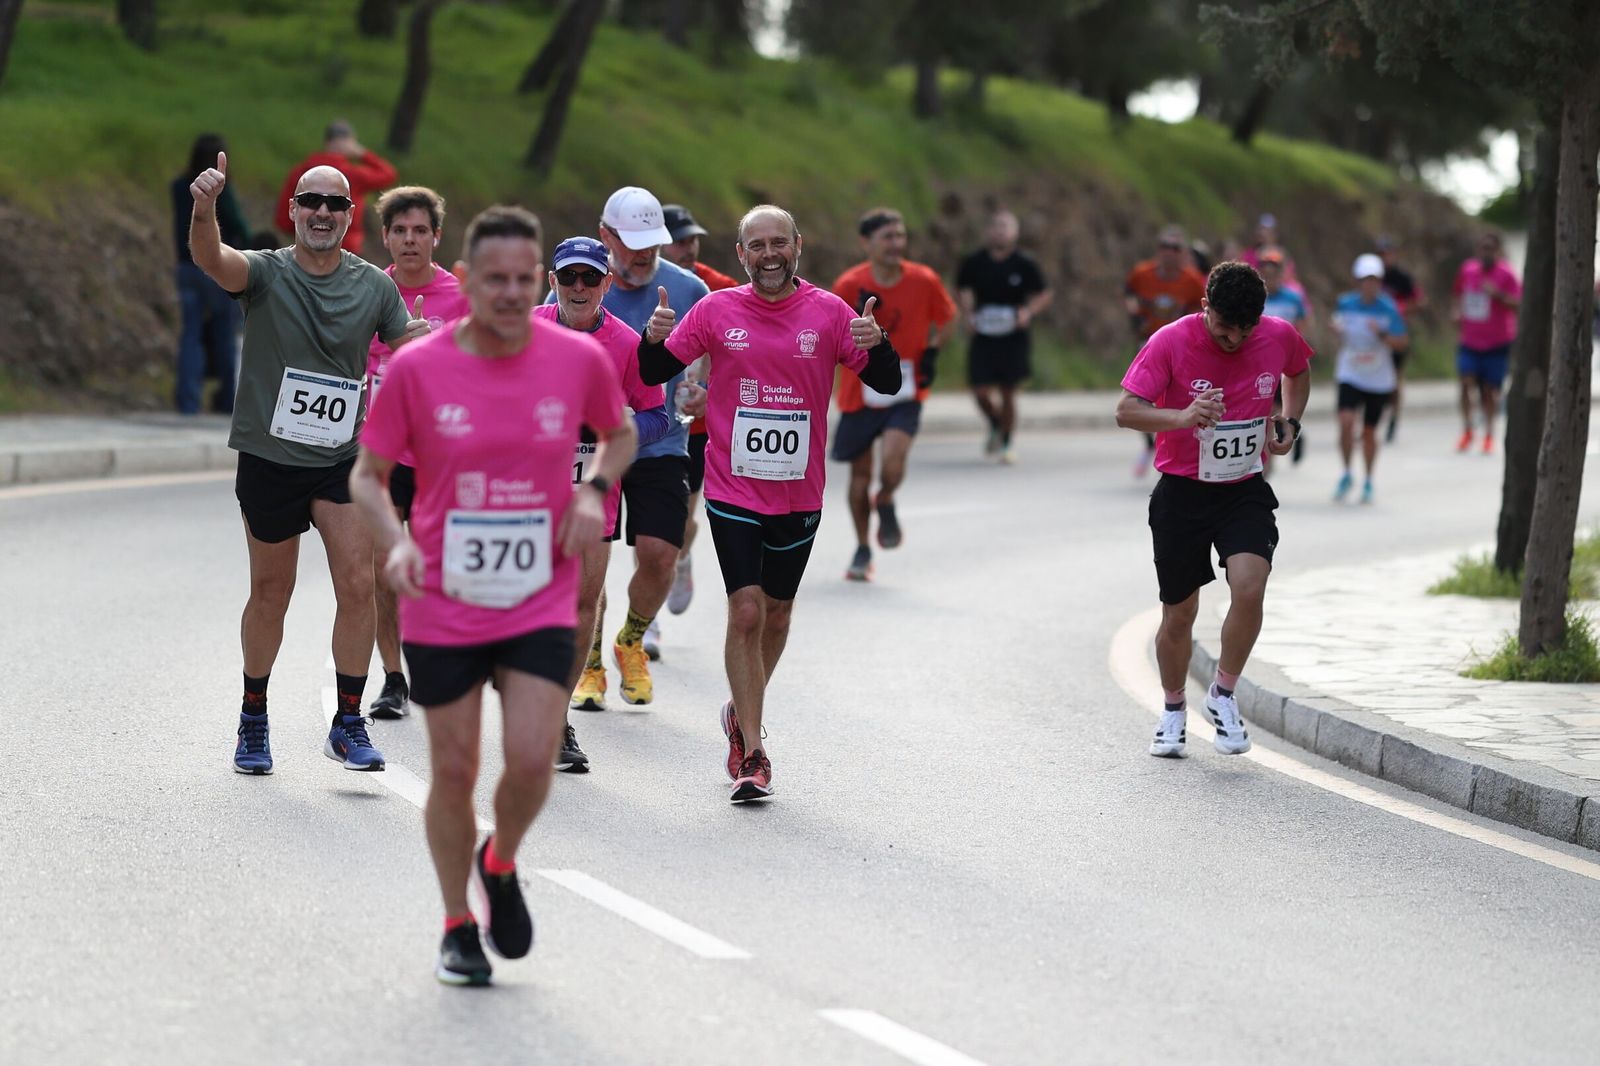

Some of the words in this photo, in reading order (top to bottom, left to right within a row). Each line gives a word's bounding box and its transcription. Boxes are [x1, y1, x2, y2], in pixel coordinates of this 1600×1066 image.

[762, 385, 793, 394] Ciudad
[762, 395, 774, 403] de
[774, 394, 804, 405] Málaga
[290, 389, 347, 423] 540
[745, 427, 799, 455] 600
[1212, 434, 1257, 460] 615
[464, 538, 536, 573] 370
